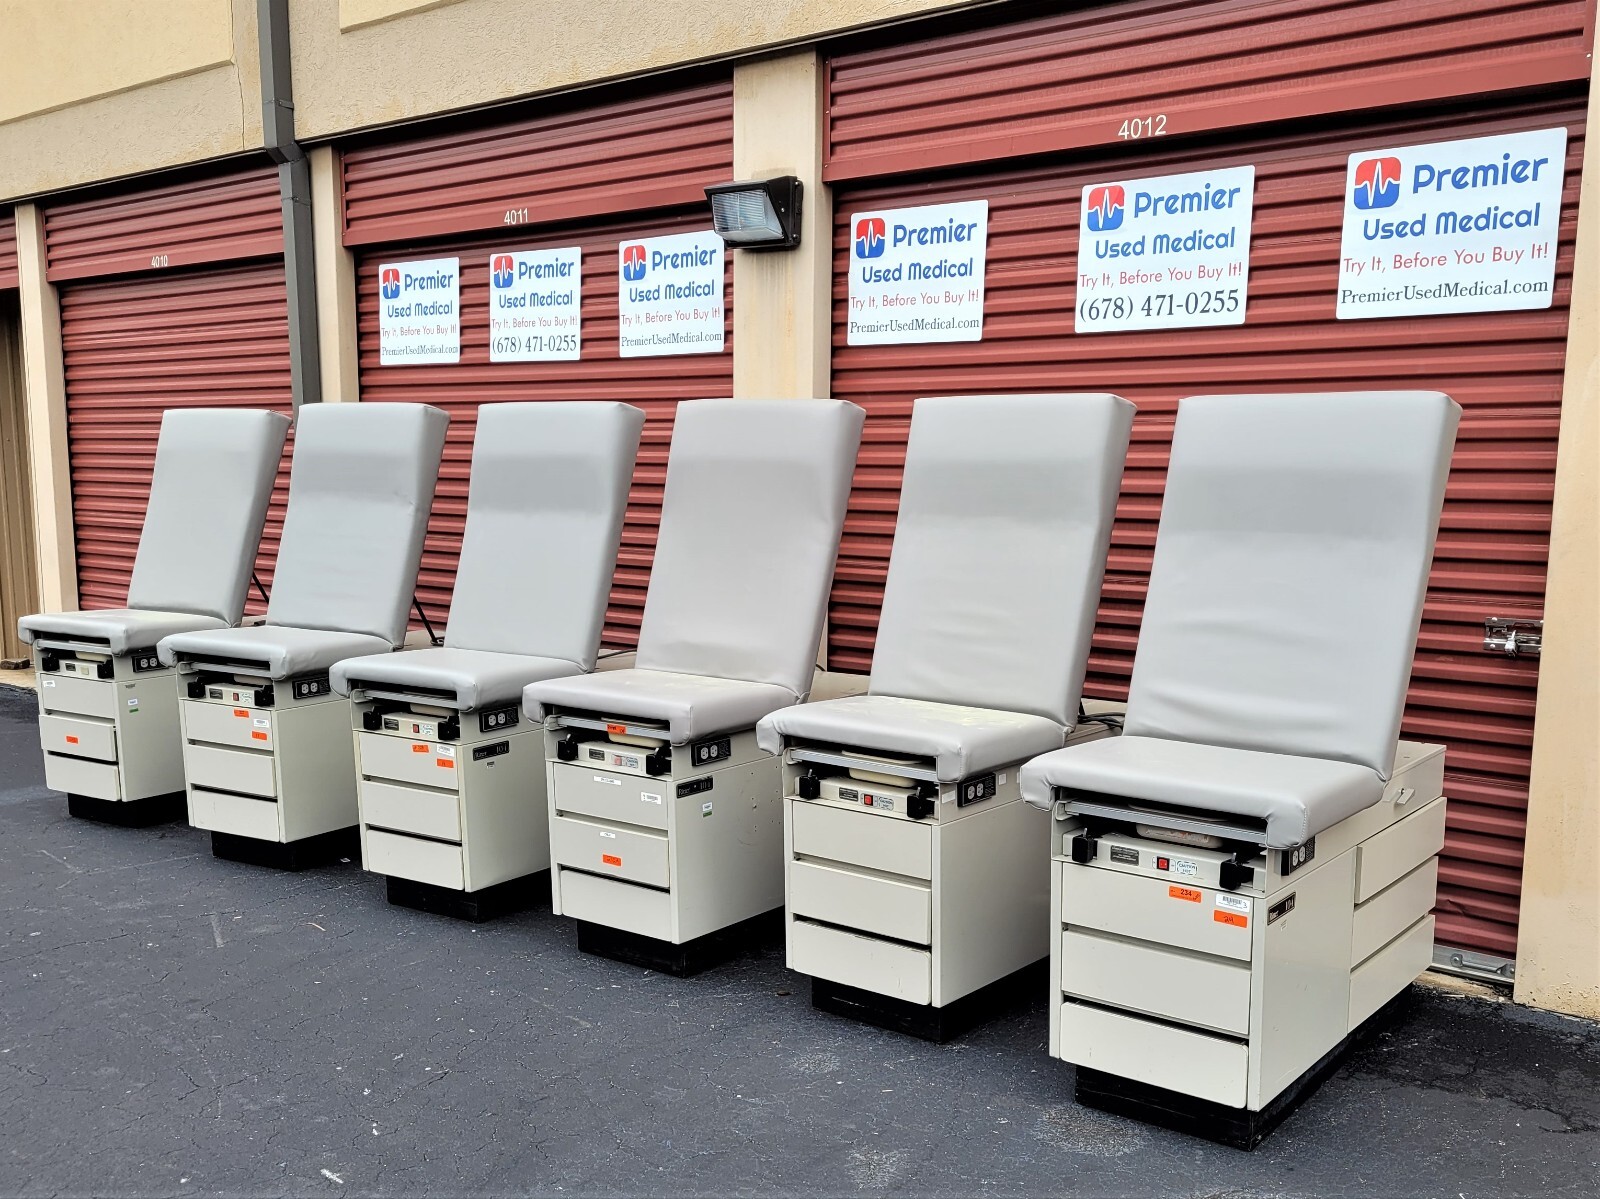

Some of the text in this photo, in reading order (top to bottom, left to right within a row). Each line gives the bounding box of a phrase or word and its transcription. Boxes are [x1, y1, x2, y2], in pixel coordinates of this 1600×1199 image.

[1118, 115, 1168, 139] 4012
[1413, 153, 1548, 194] Premier
[1134, 183, 1241, 218] Premier
[504, 208, 529, 225] 4011
[1363, 202, 1540, 240] Used Medical
[893, 218, 977, 247] Premier
[1095, 227, 1235, 259] Used Medical
[151, 255, 168, 268] 4010
[652, 245, 716, 270] Premier
[1344, 242, 1548, 276] Try It, Before You Buy It!
[518, 258, 574, 280] Premier
[862, 258, 973, 284] Used Medical
[1080, 262, 1242, 289] Try It, Before You Buy It!
[404, 271, 453, 291] Premier
[629, 280, 715, 303] Used Medical
[1341, 280, 1548, 304] PremierUsedMedical.com
[387, 301, 453, 318] Used Medical
[499, 291, 573, 309] Used Medical
[850, 290, 978, 310] Try It, Before You Buy It!
[1079, 289, 1239, 323] (678) 471-0255
[491, 319, 503, 330] Try
[513, 317, 535, 328] Before
[538, 317, 552, 327] You
[554, 317, 567, 328] Buy
[621, 314, 633, 326] Try
[645, 311, 672, 323] Before
[675, 310, 691, 321] You
[693, 309, 709, 322] Buy
[849, 317, 979, 334] PremierUsedMedical.com
[492, 335, 577, 354] (678) 471-0255
[621, 332, 722, 347] PremierUsedMedical.com
[1180, 888, 1192, 896] 234
